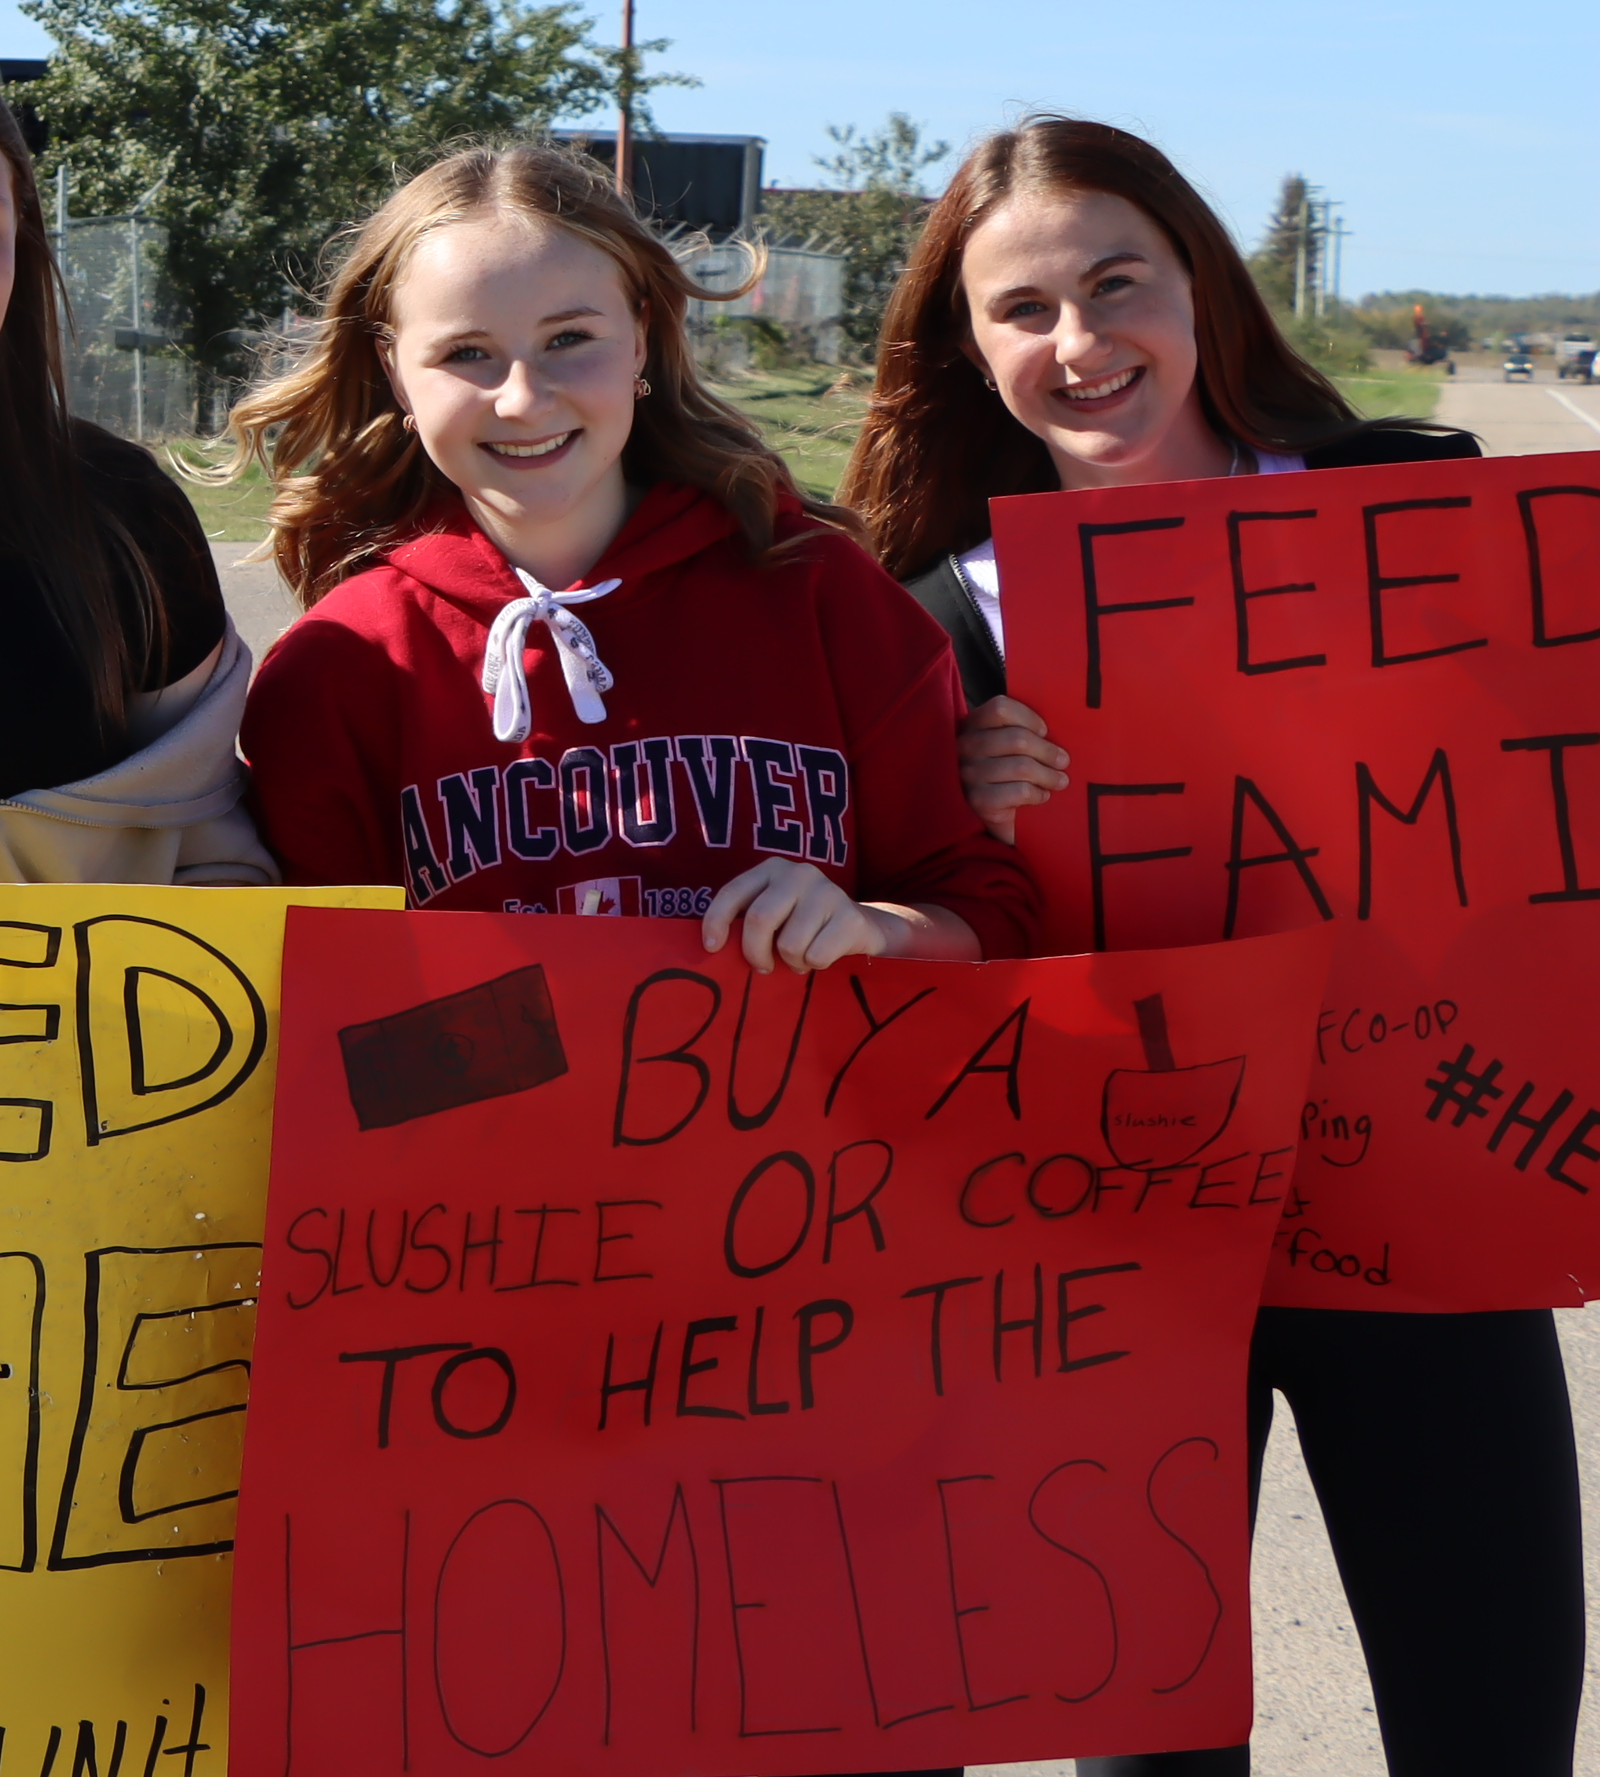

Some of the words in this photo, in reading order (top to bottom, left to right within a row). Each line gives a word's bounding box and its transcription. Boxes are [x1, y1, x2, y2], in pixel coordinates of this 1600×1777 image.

[1078, 484, 1600, 709] FEED
[645, 887, 713, 917] 1886
[1087, 732, 1600, 953] FAMI
[614, 967, 936, 1148] BUY
[926, 997, 1033, 1121] A
[1114, 1113, 1197, 1128] slushie
[1424, 1043, 1600, 1195] #HE
[287, 1201, 663, 1310] SLUSHIE
[723, 1138, 892, 1279] OR
[958, 1146, 1296, 1229] COFFEE
[338, 1342, 517, 1449] TO
[598, 1299, 854, 1430] HELP
[902, 1262, 1142, 1396] THE
[285, 1436, 1222, 1777] HOMELESS
